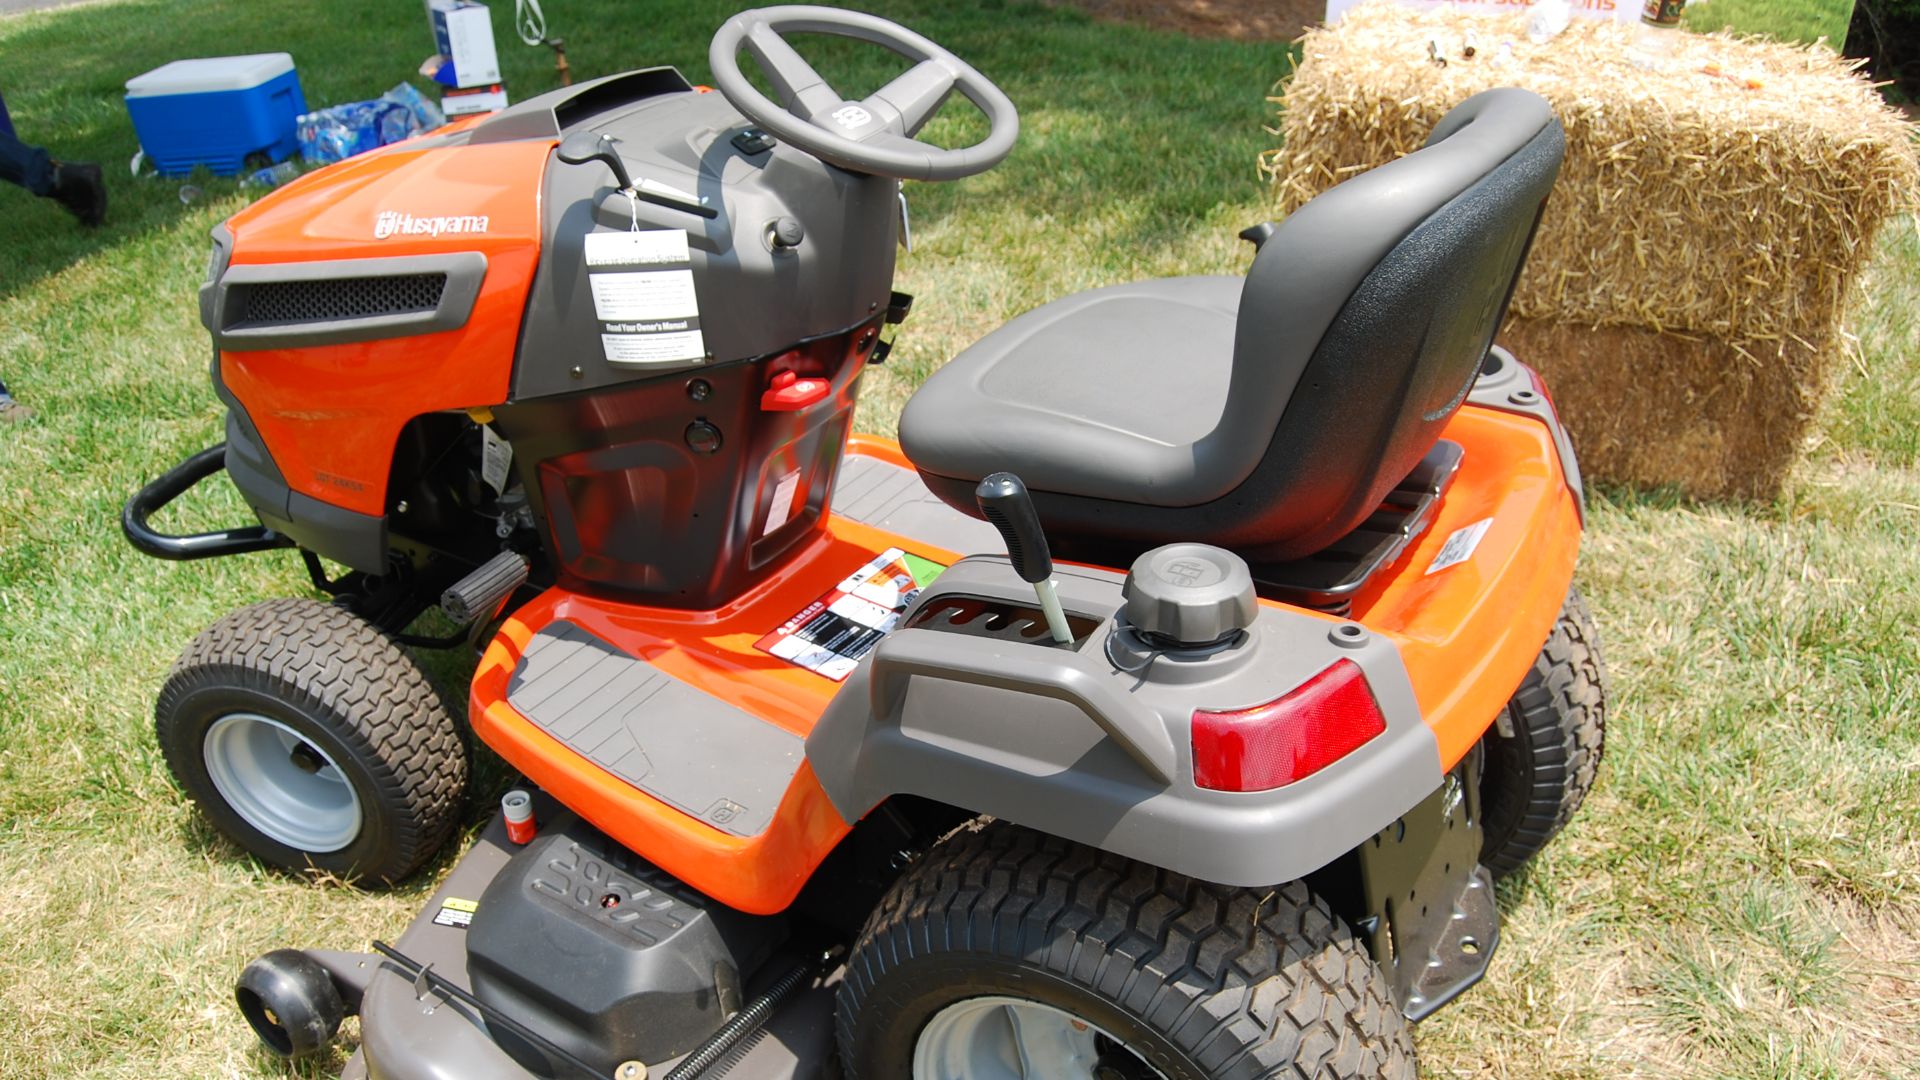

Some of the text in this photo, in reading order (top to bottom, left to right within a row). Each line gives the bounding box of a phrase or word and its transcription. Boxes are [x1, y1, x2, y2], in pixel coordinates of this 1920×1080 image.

[393, 213, 488, 237] Husqvarna
[657, 254, 685, 264] System
[606, 321, 687, 332] Read Your Owner's Manual
[785, 601, 824, 628] DANGER
